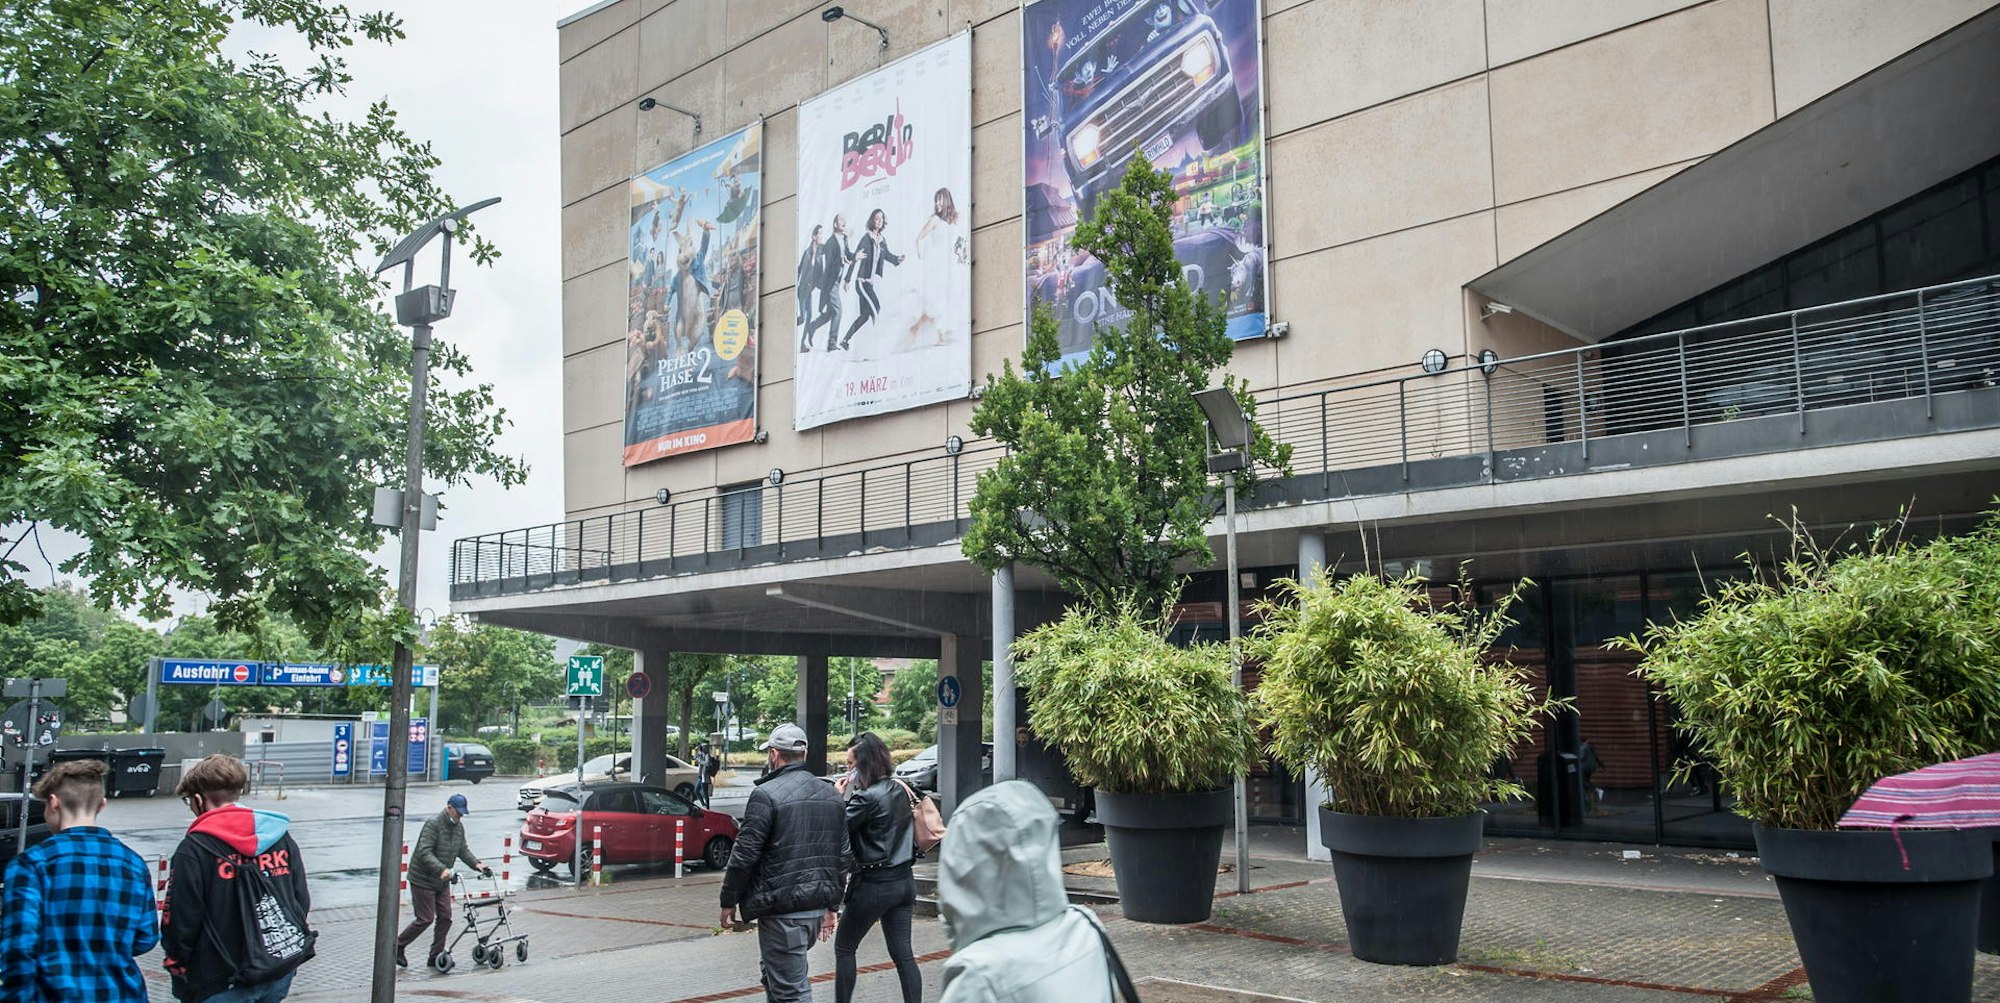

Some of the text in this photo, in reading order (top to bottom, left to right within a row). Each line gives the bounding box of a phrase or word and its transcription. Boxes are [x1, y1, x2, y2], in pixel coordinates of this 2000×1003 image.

[1082, 5, 1102, 26] ZWEI
[1065, 31, 1087, 49] VOLL
[1088, 8, 1114, 33] NEBEN
[657, 351, 698, 377] PETER
[659, 368, 694, 393] HASE
[697, 346, 713, 384] 2
[845, 383, 857, 397] 19.
[859, 375, 888, 395] MÄRZ
[672, 438, 683, 449] IM
[684, 433, 706, 447] KINO
[172, 664, 230, 679] Ausfahrt
[291, 673, 322, 683] Einfahrt
[339, 726, 346, 735] 3
[127, 765, 149, 773] avea
